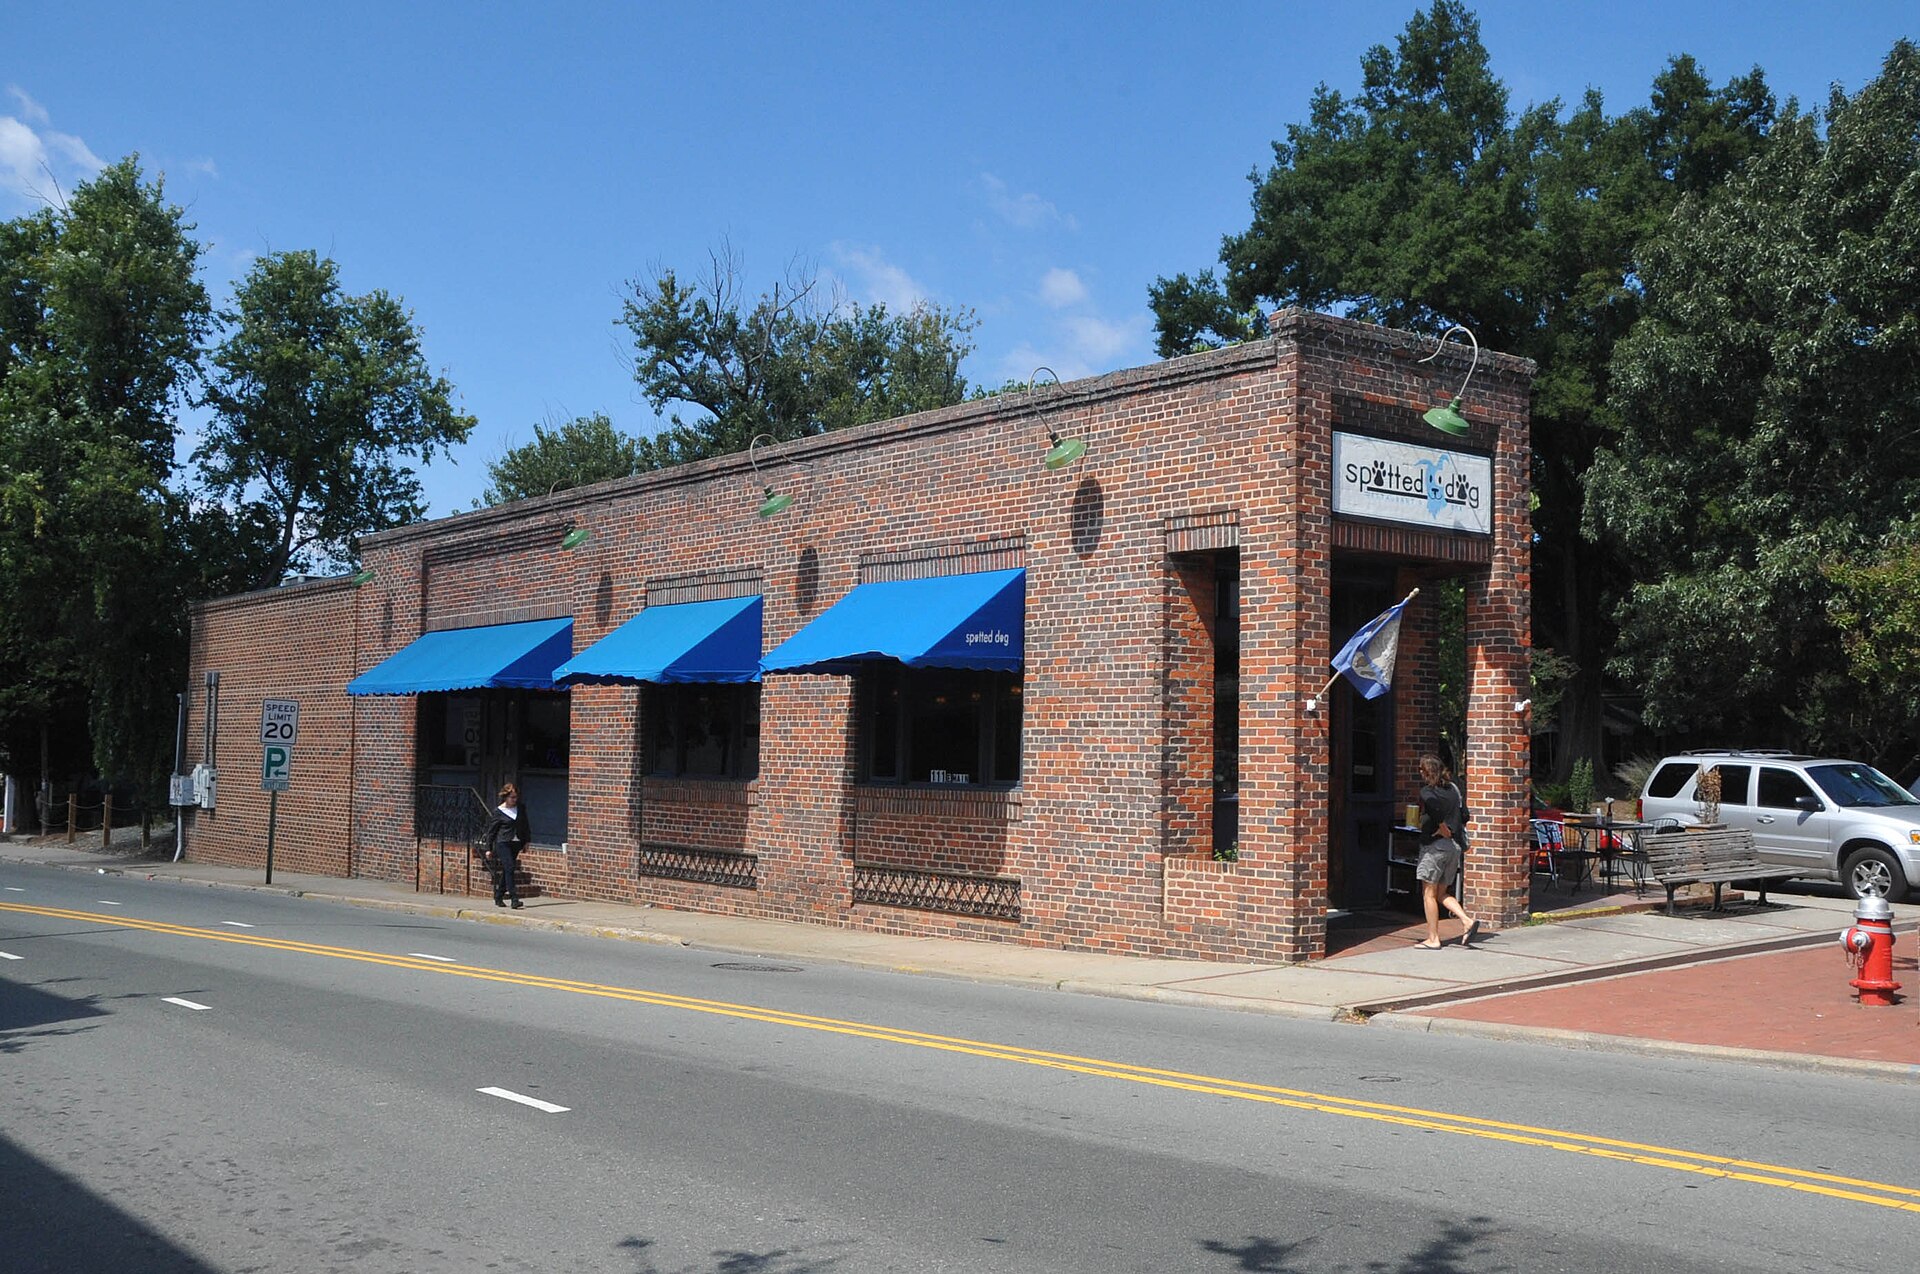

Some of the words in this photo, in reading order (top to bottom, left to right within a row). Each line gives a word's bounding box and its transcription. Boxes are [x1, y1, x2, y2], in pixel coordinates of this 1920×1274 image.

[1345, 460, 1424, 493] spotted
[1445, 473, 1479, 508] dog
[965, 629, 993, 646] spotted
[994, 629, 1009, 647] dog
[265, 704, 296, 712] SPEED
[268, 713, 292, 721] LIMIT
[264, 722, 293, 739] 20
[265, 747, 286, 777] P
